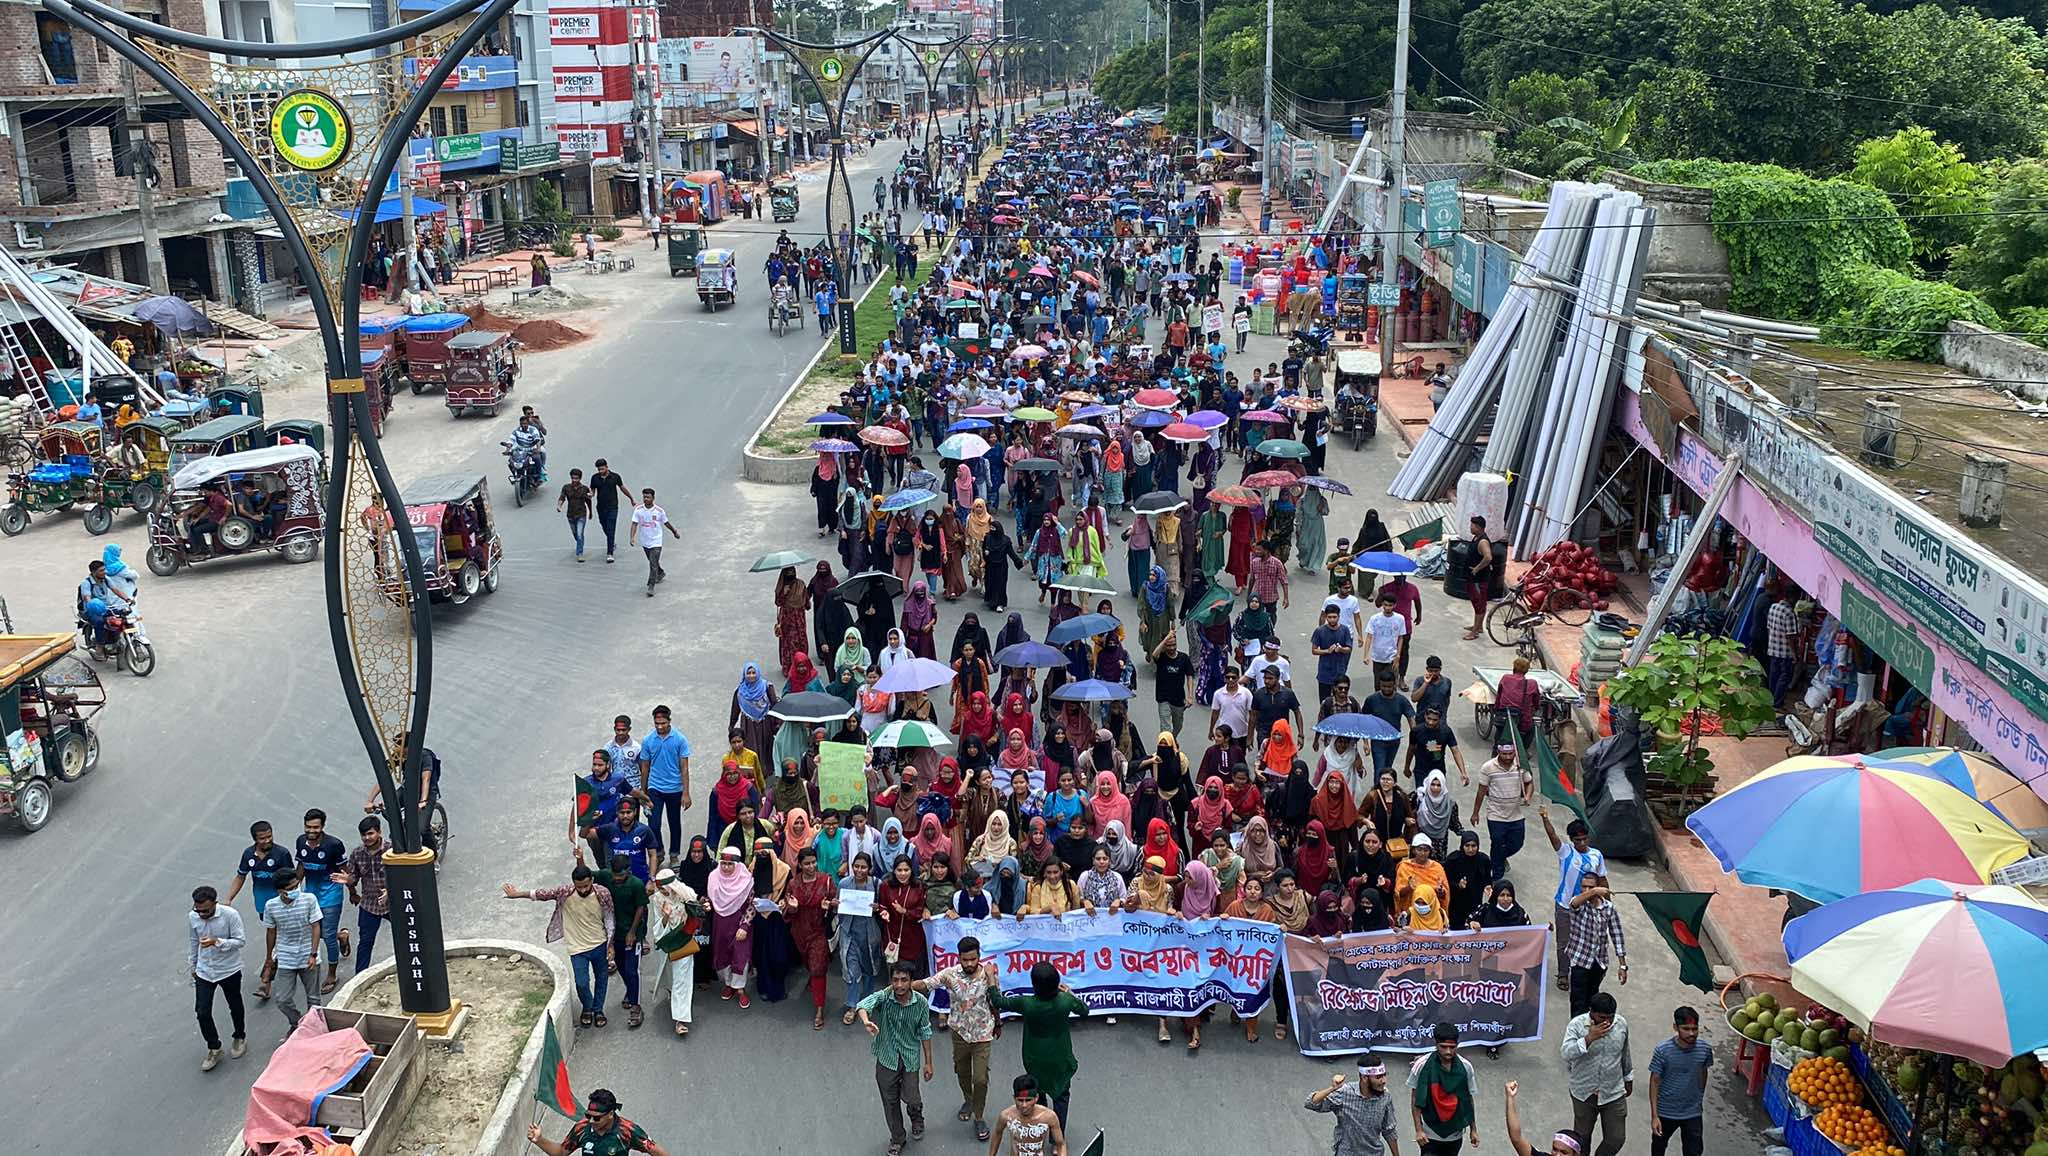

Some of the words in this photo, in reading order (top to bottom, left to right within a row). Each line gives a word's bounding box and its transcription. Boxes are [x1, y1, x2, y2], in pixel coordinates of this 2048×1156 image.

[560, 18, 590, 28] PREMIER
[560, 27, 590, 35] cement
[563, 75, 594, 86] PREMIER
[564, 85, 594, 93] cement
[568, 132, 599, 143] PREMIER
[272, 130, 296, 162] RAJSHAHI
[296, 158, 312, 167] CITY
[312, 129, 346, 167] CORPORATION
[1946, 544, 1980, 592] ফুডস
[1236, 926, 1279, 944] দাবিতে
[1093, 946, 1112, 971] ও
[1119, 946, 1200, 977] অবস্থান
[1206, 943, 1277, 991] কর্মসূচি
[1134, 987, 1185, 1009] রাজশাহী
[1318, 979, 1381, 1011] বিক্ষোভ
[1380, 978, 1428, 1011] মিছিল
[1429, 980, 1447, 1003] ও
[1450, 980, 1517, 1007] পদযাত্রা
[1320, 1026, 1351, 1041] রাজশাহী
